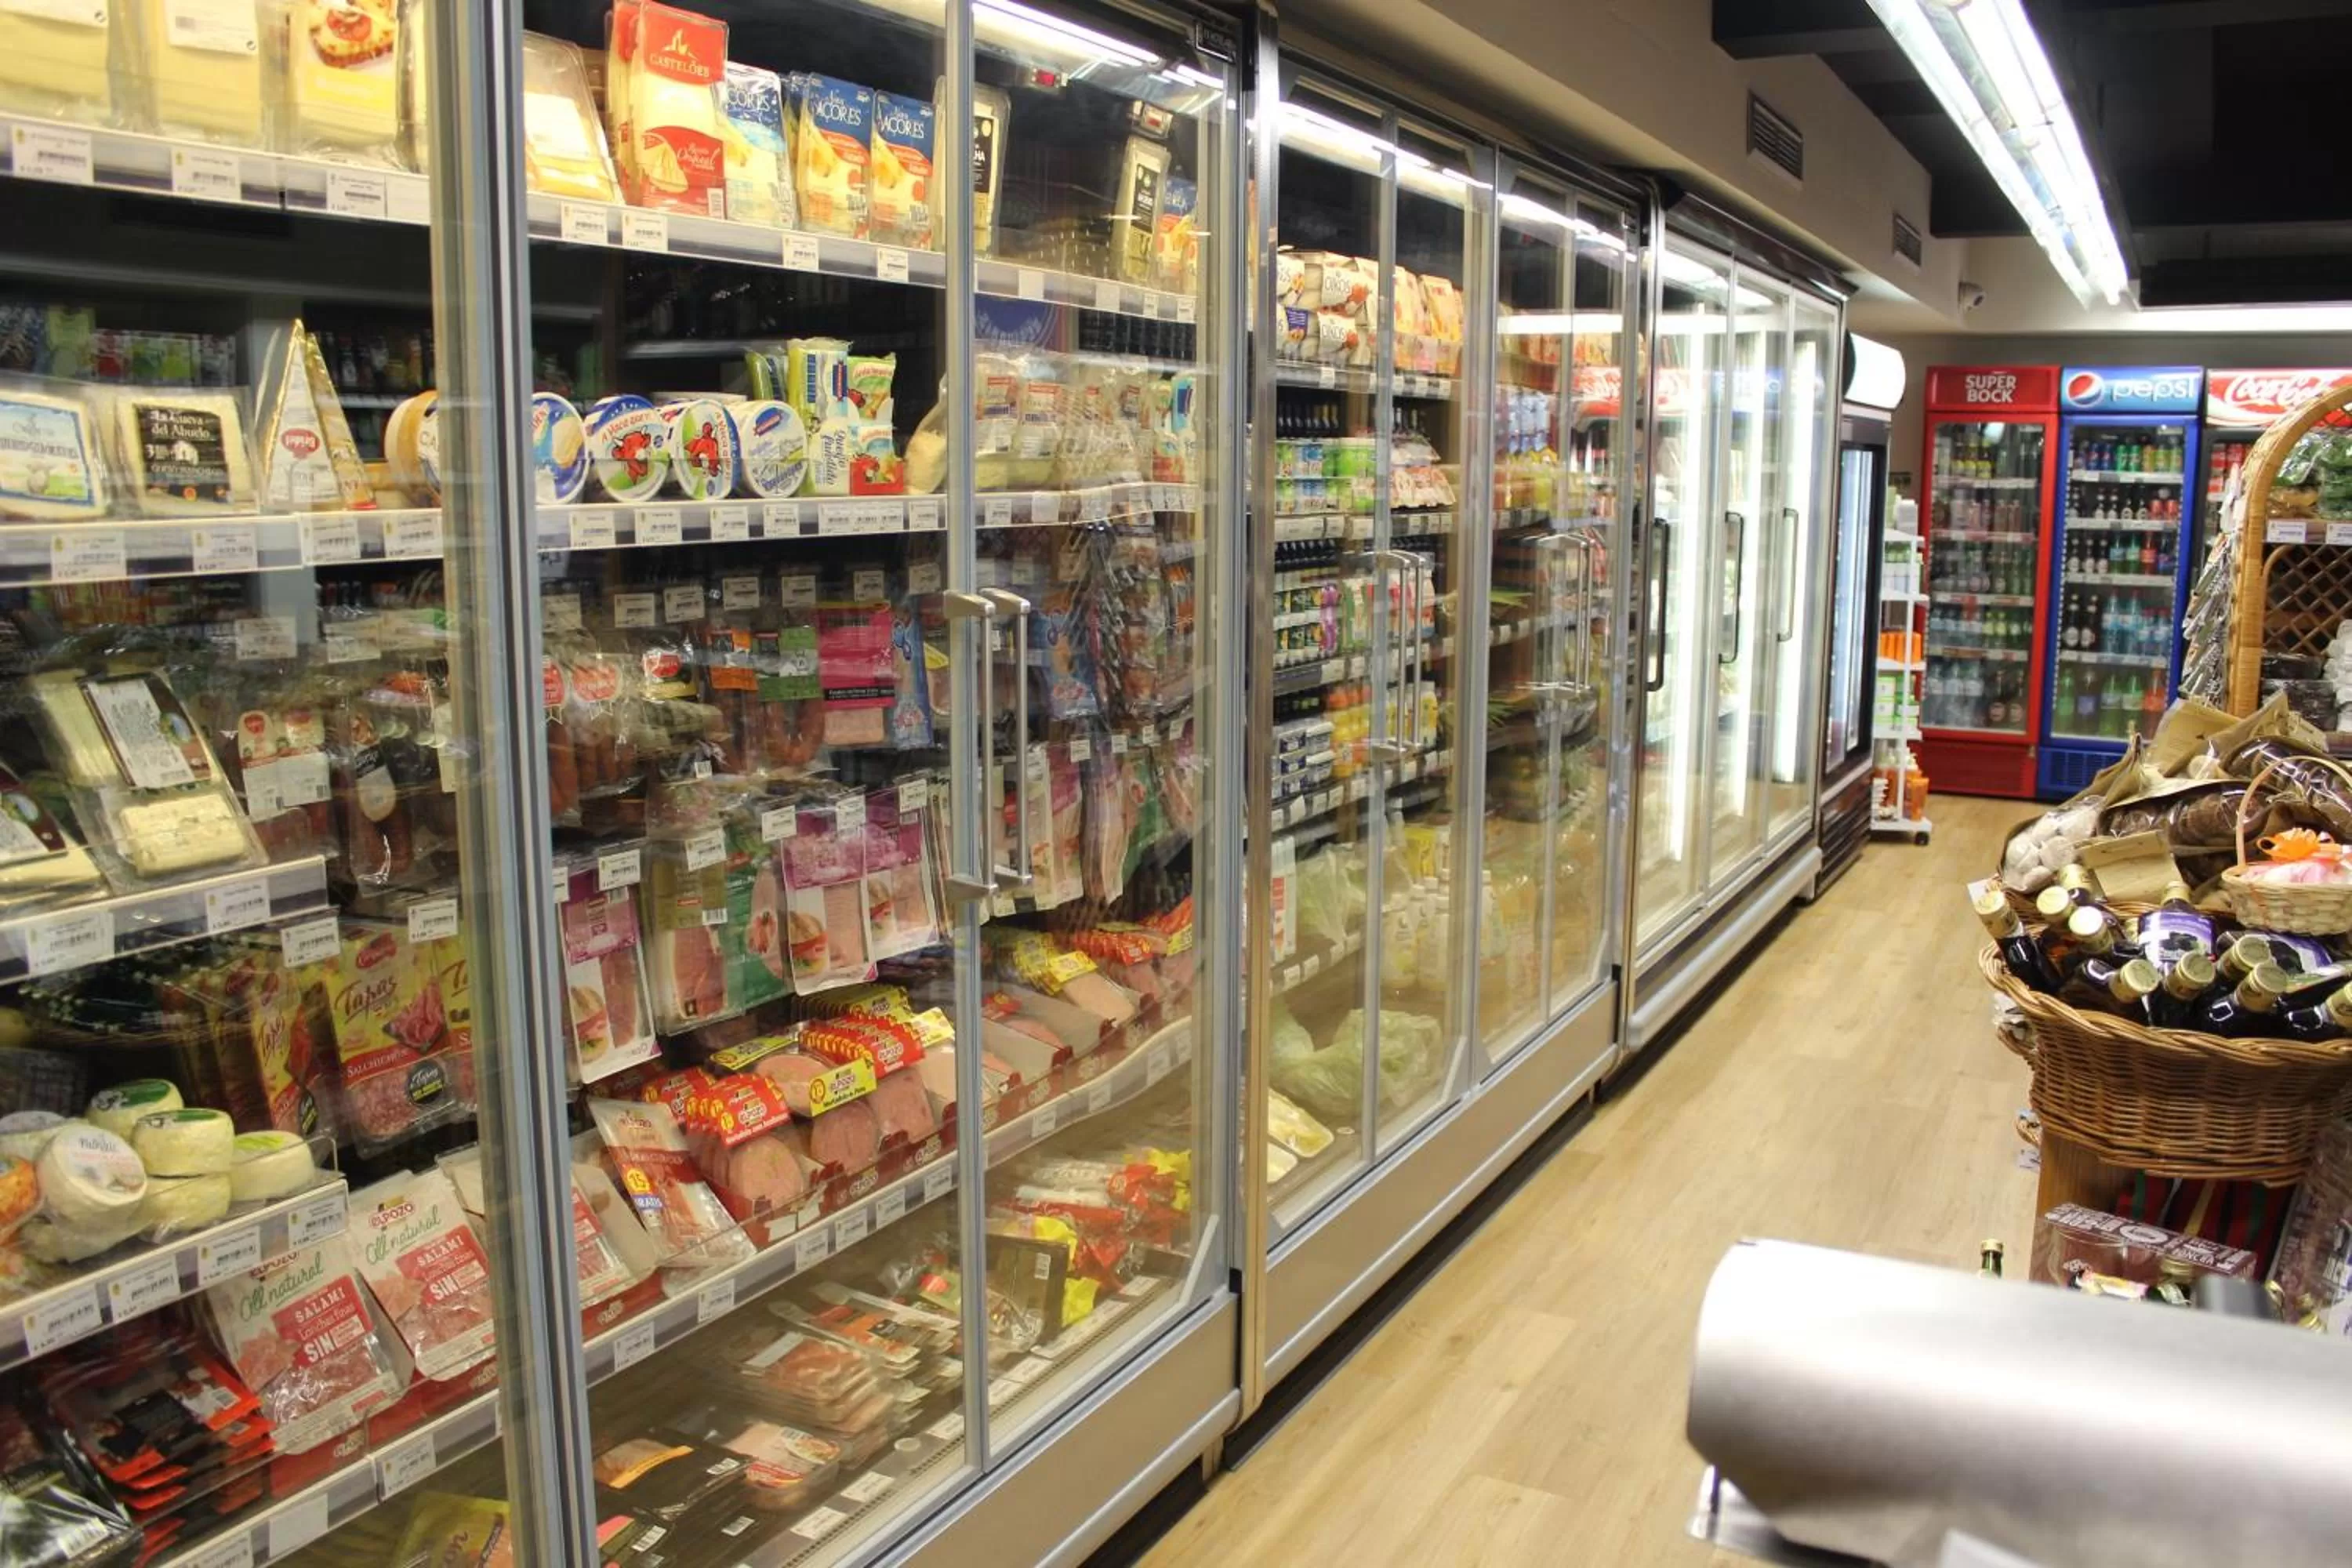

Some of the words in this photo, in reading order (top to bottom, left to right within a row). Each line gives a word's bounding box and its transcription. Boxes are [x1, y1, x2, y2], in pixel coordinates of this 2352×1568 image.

[650, 53, 710, 78] CASTELÕES
[815, 100, 862, 125] AÇORES
[880, 116, 925, 140] AÇORES
[1965, 375, 2016, 390] SUPER
[1966, 389, 2013, 402] BOCK
[2112, 375, 2194, 401] pepsi
[335, 975, 398, 1022] Tapas
[371, 1203, 414, 1228] ELPOZO
[390, 1203, 441, 1248] natural
[416, 1235, 465, 1267] SALAMI
[268, 1250, 325, 1302] natural
[430, 1273, 459, 1301] SIN
[293, 1286, 347, 1324] SALAMI
[303, 1332, 336, 1363] SIN
